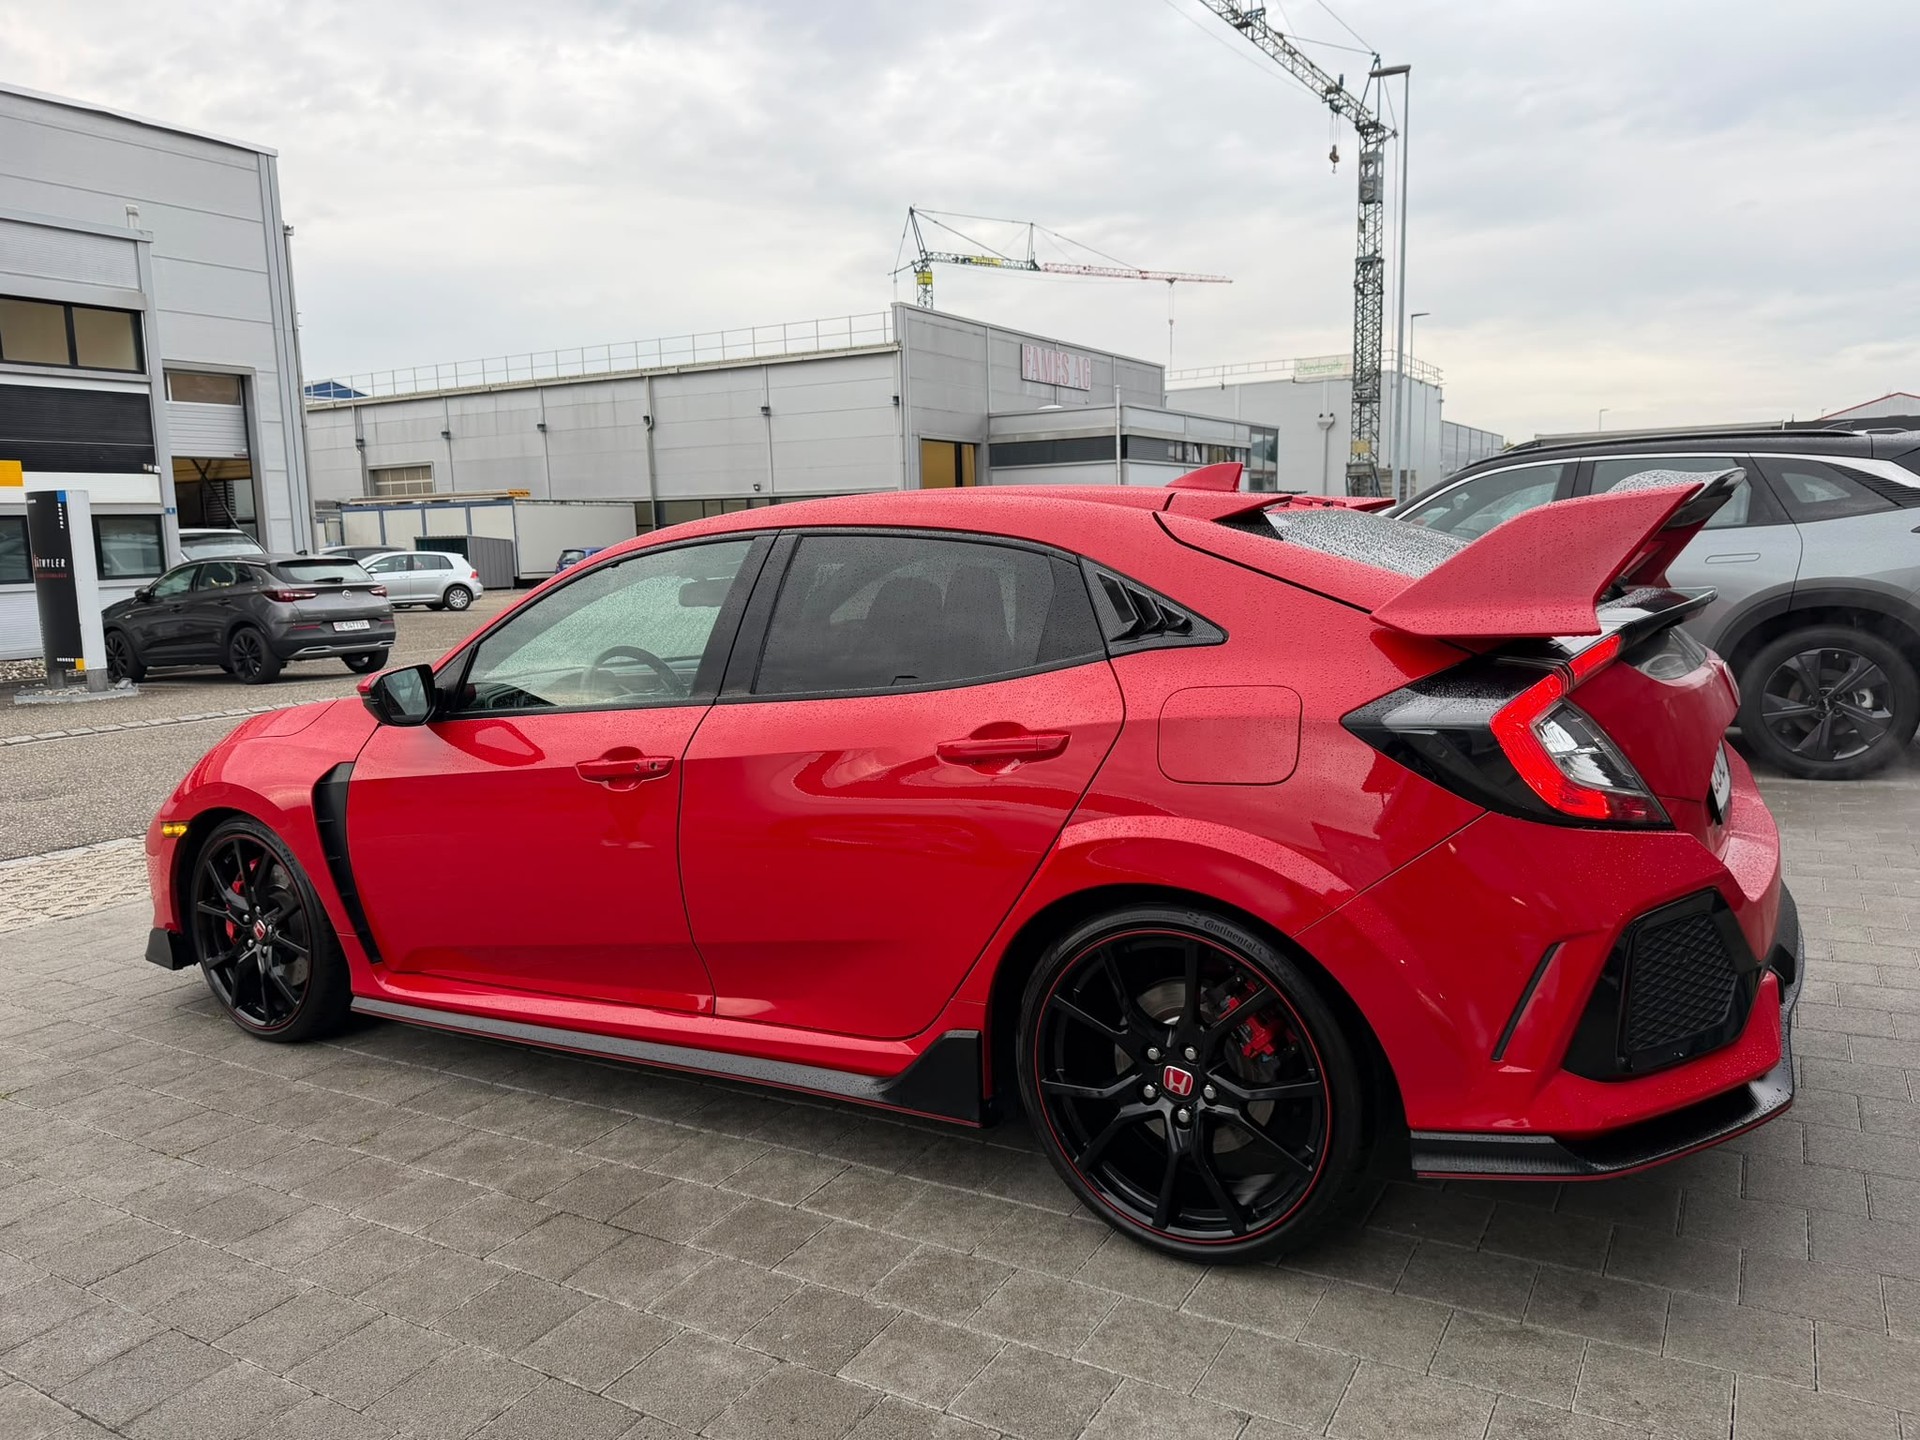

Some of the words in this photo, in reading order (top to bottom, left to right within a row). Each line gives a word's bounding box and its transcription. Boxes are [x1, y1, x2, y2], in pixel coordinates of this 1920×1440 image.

[1023, 345, 1069, 384] FAMES
[1073, 355, 1091, 388] AG
[1203, 918, 1258, 952] Continental
